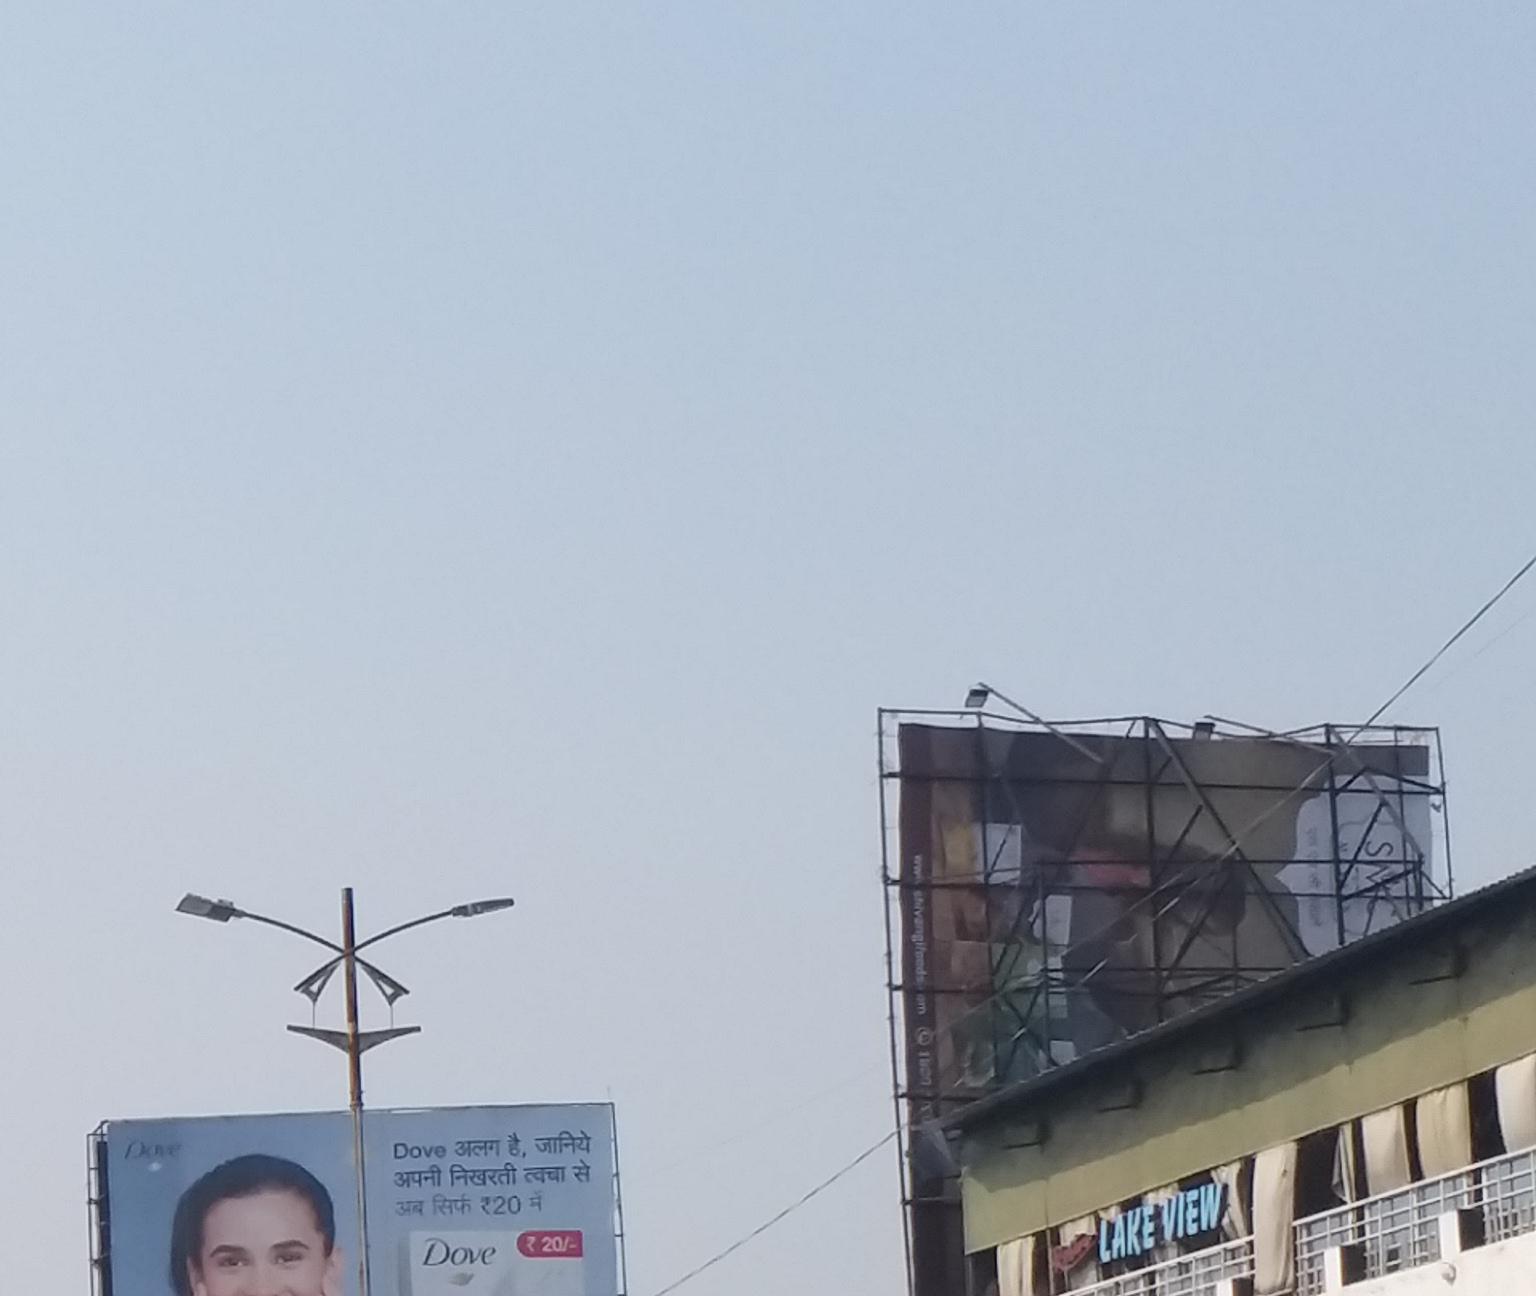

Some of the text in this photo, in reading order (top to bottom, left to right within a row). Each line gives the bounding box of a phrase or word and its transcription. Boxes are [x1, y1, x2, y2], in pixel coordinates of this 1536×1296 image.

[393, 1142, 447, 1159] Dove
[455, 1139, 501, 1158] अलग
[534, 1130, 592, 1155] जानिये
[393, 1159, 592, 1189] अपनी निखरती त्वचा से
[395, 1200, 424, 1217] अब
[480, 1195, 521, 1216] ₹20
[1099, 1182, 1222, 1265] LAKE VIEW
[422, 1238, 496, 1266] Dove
